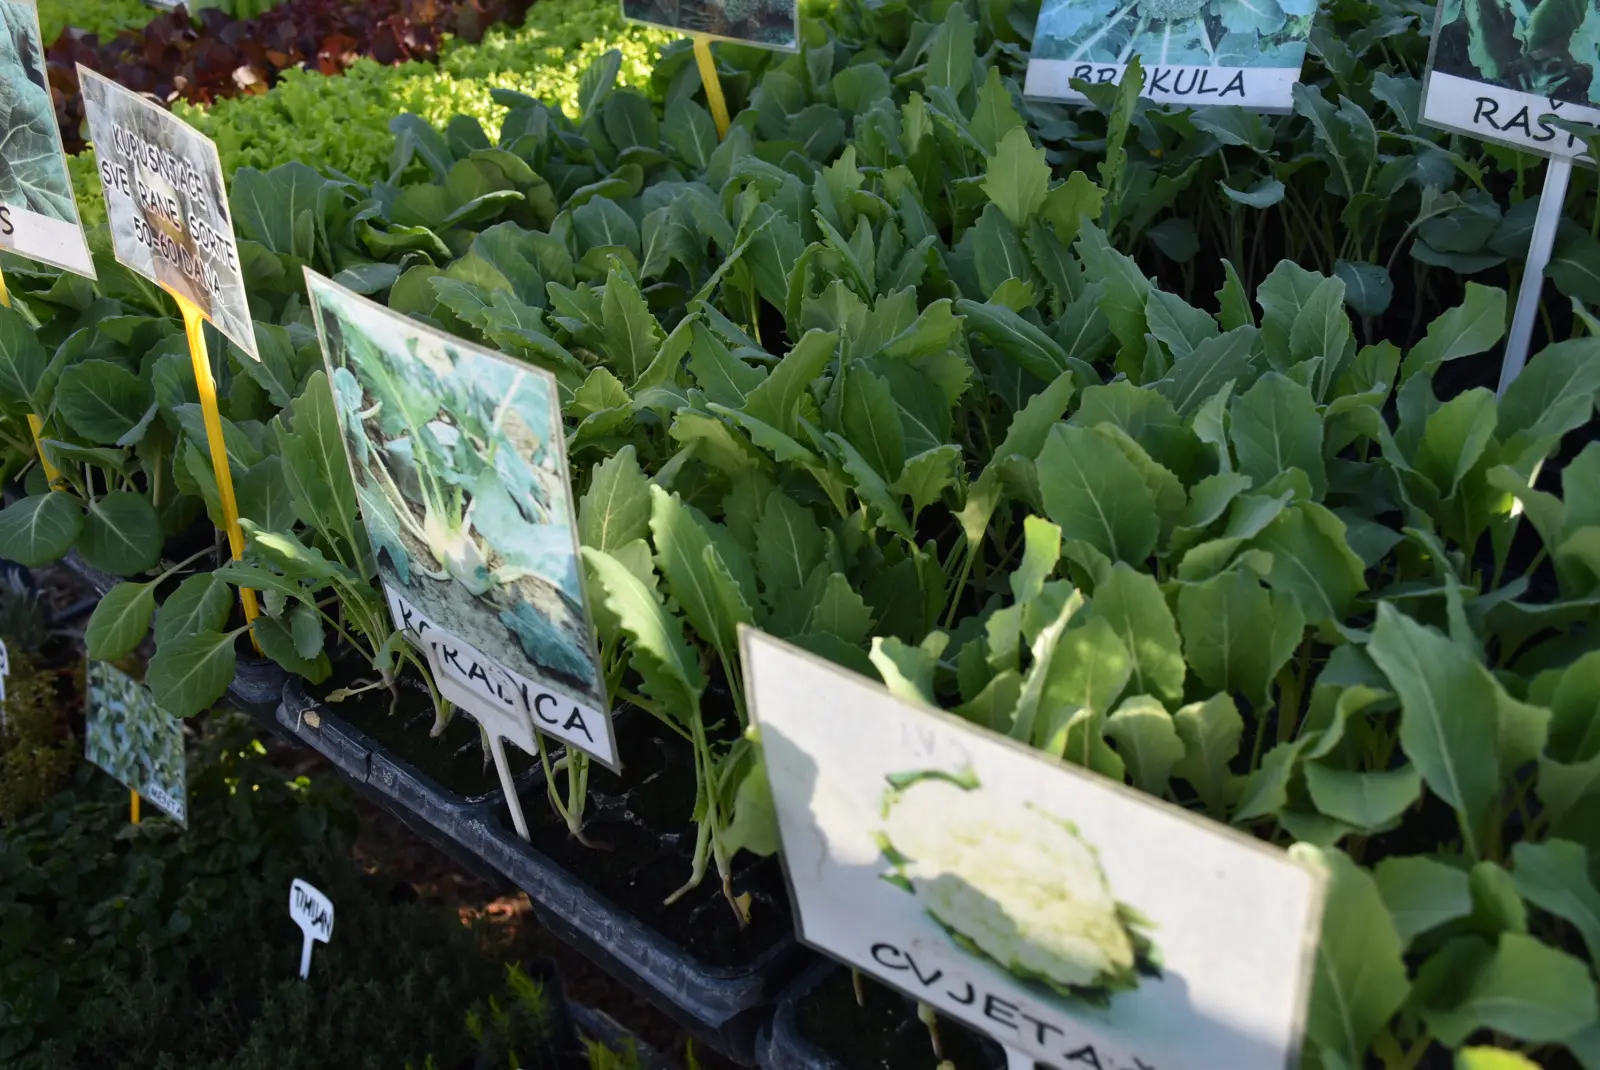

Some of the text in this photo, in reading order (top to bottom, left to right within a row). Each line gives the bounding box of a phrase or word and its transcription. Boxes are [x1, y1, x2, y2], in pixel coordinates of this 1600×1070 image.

[1073, 64, 1246, 98] BRKULA
[101, 159, 237, 272] SVE RANE SORTE
[133, 216, 223, 301] 50-60 DANA
[870, 943, 1156, 1070] CVJETA
